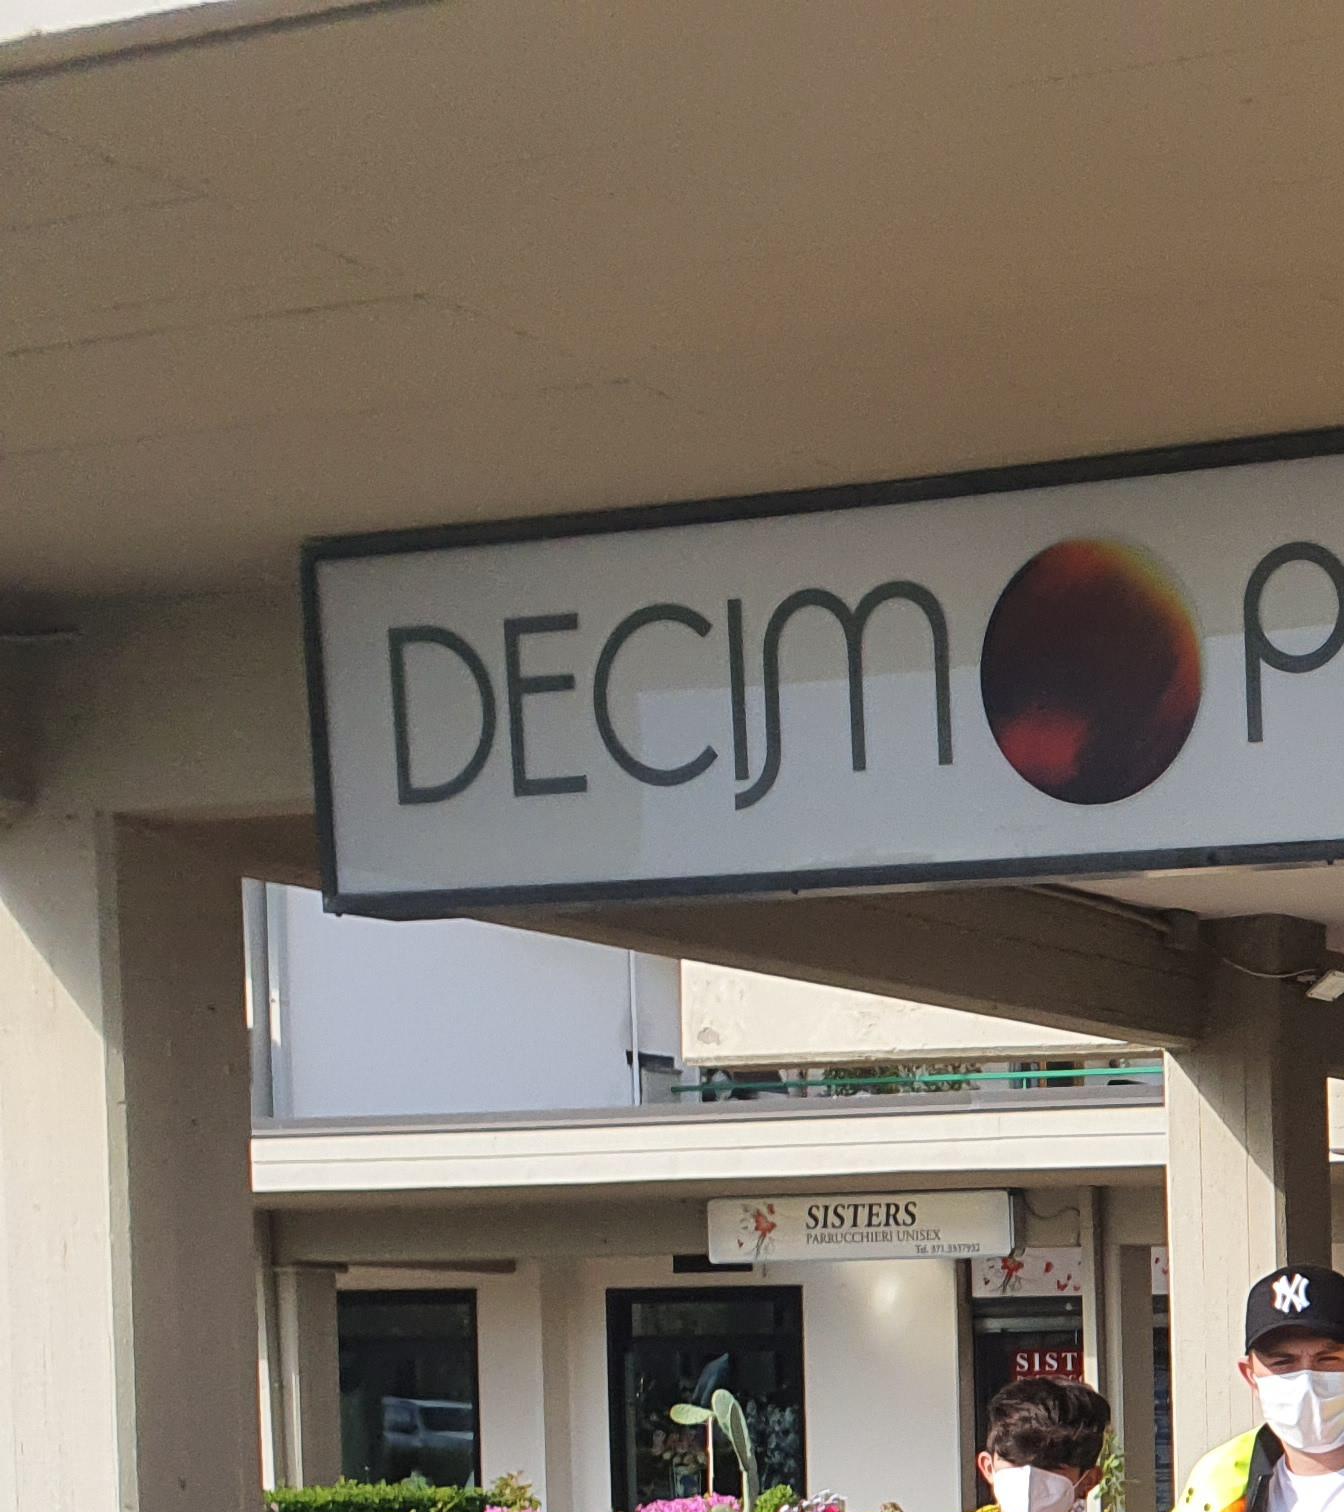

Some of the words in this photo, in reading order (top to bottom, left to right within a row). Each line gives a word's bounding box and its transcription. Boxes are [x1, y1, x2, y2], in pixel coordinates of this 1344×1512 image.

[806, 1201, 918, 1229] SISTERS
[806, 1230, 893, 1244] PARRUCCHIERI
[897, 1229, 941, 1242] UNISEX
[1016, 1352, 1078, 1372] SIST
